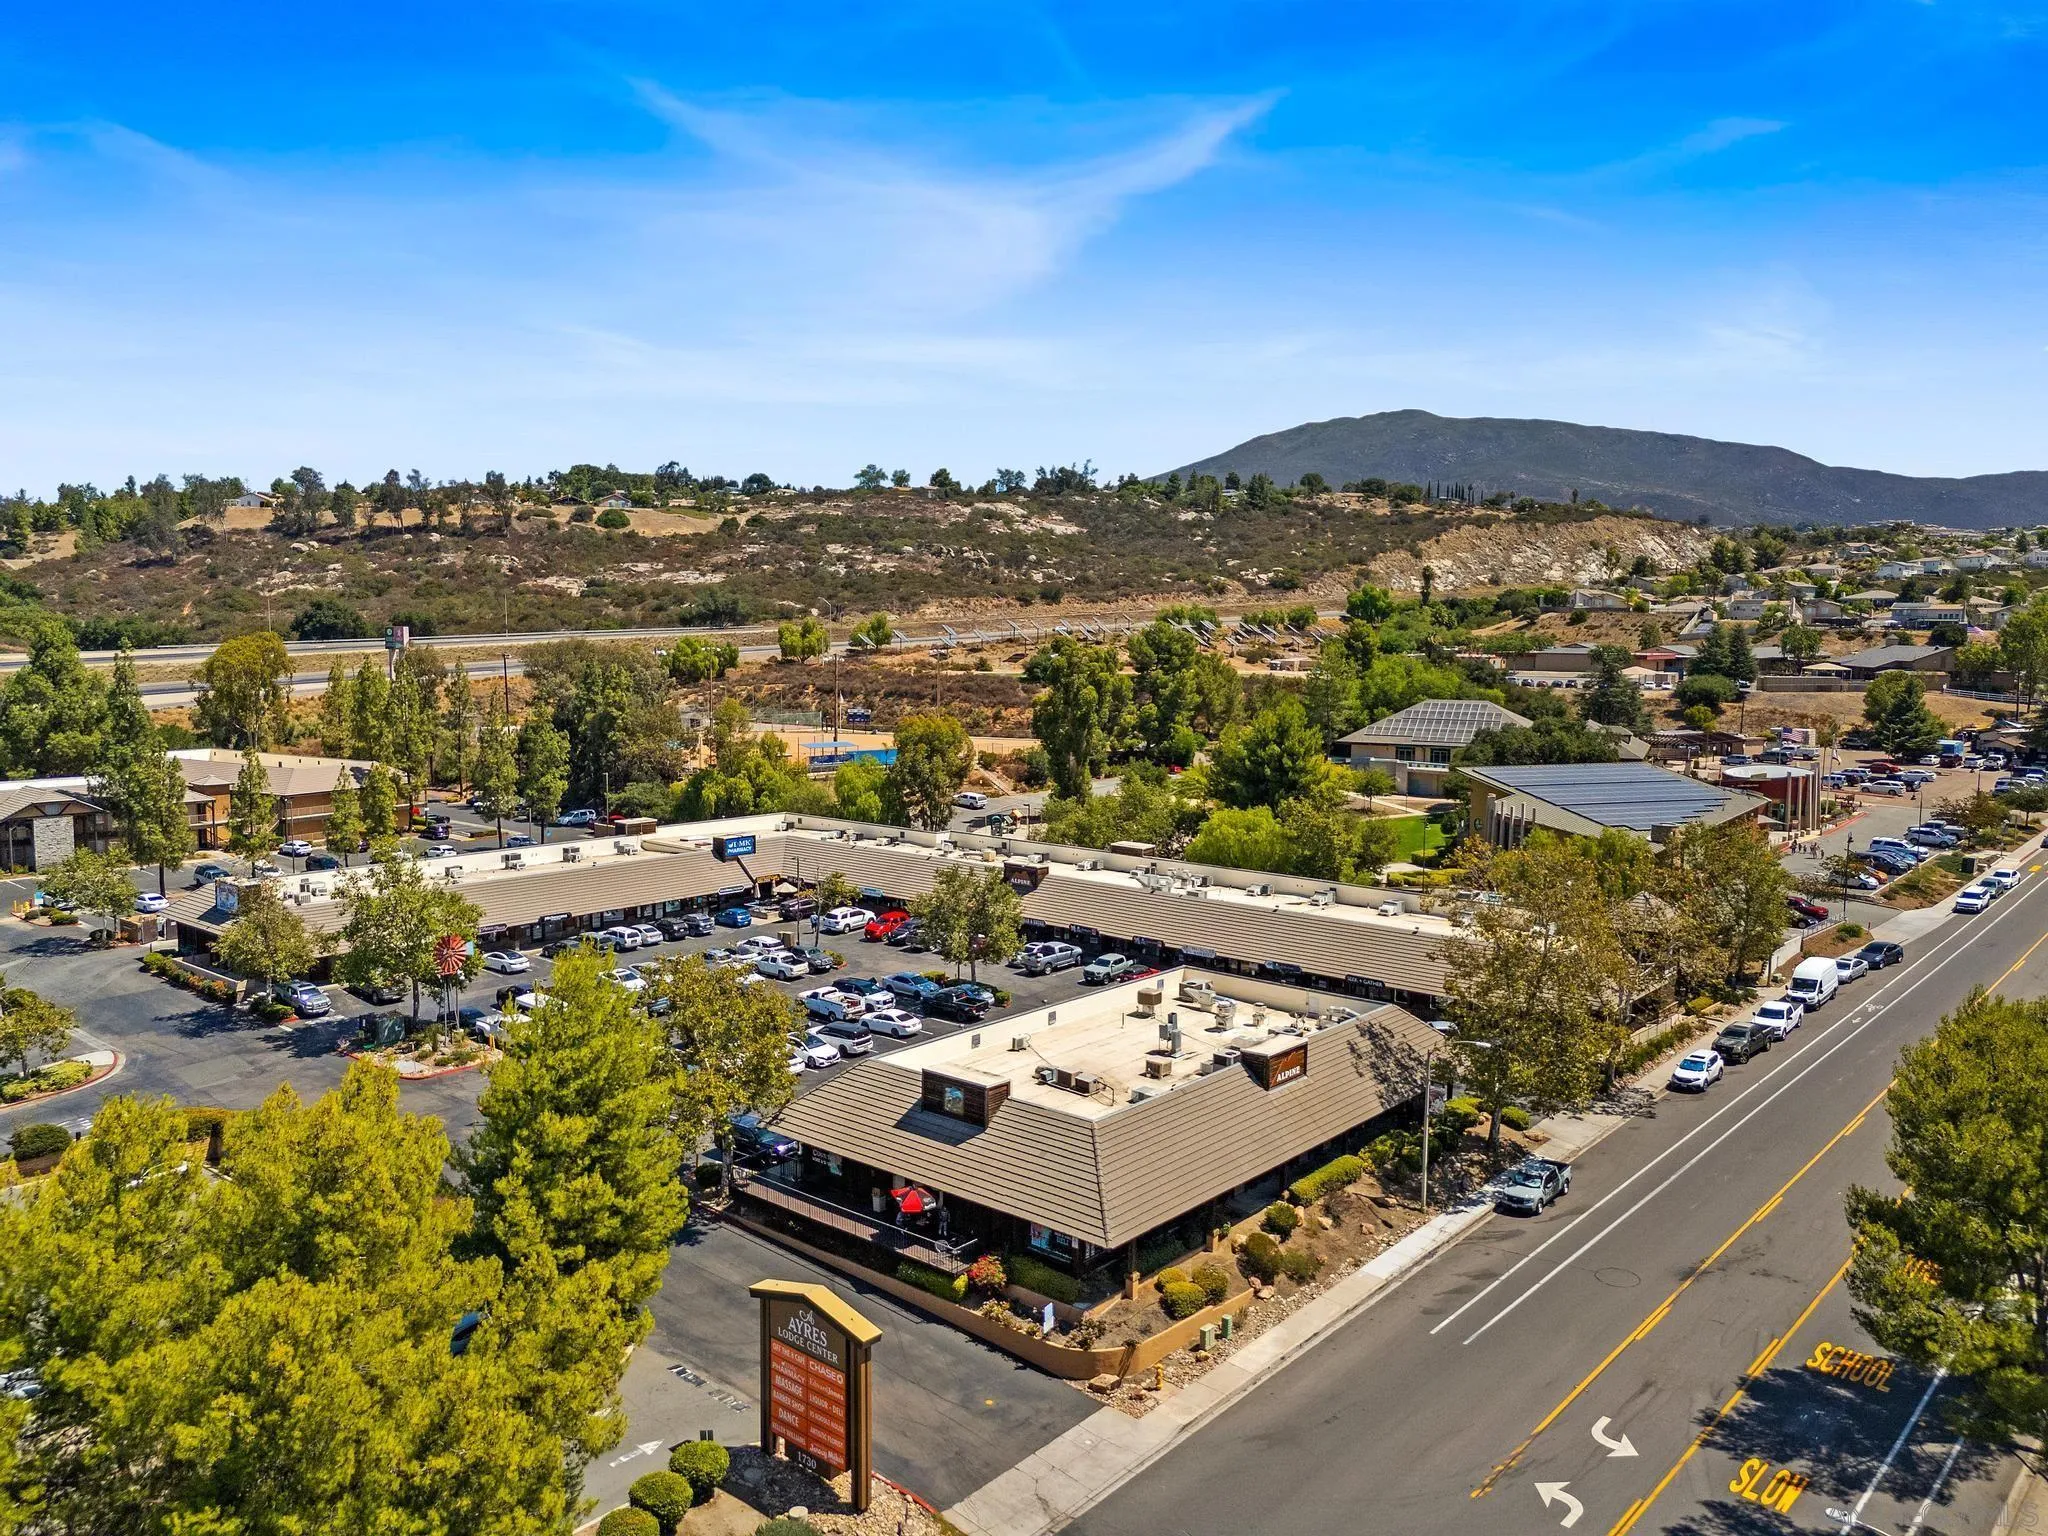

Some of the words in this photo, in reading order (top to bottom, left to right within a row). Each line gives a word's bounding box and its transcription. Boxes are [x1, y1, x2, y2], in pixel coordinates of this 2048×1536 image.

[728, 846, 752, 854] PHARMACY
[1011, 878, 1031, 887] ALPINE
[1363, 979, 1383, 988] GATHER
[1276, 1066, 1301, 1082] ALPINE
[788, 1317, 827, 1347] AYRES
[777, 1326, 805, 1347] LODGE
[806, 1340, 839, 1364] CENTER
[809, 1361, 837, 1381] CHASE
[1806, 1342, 1897, 1393] SCHOOL
[775, 1374, 801, 1397] MASSAGE
[791, 1399, 804, 1413] SHOP
[810, 1394, 828, 1410] LIQUOR
[832, 1404, 843, 1417] DELI
[778, 1407, 798, 1427] DANCE
[797, 1451, 817, 1469] 1730
[1729, 1457, 1809, 1514] SLOW
